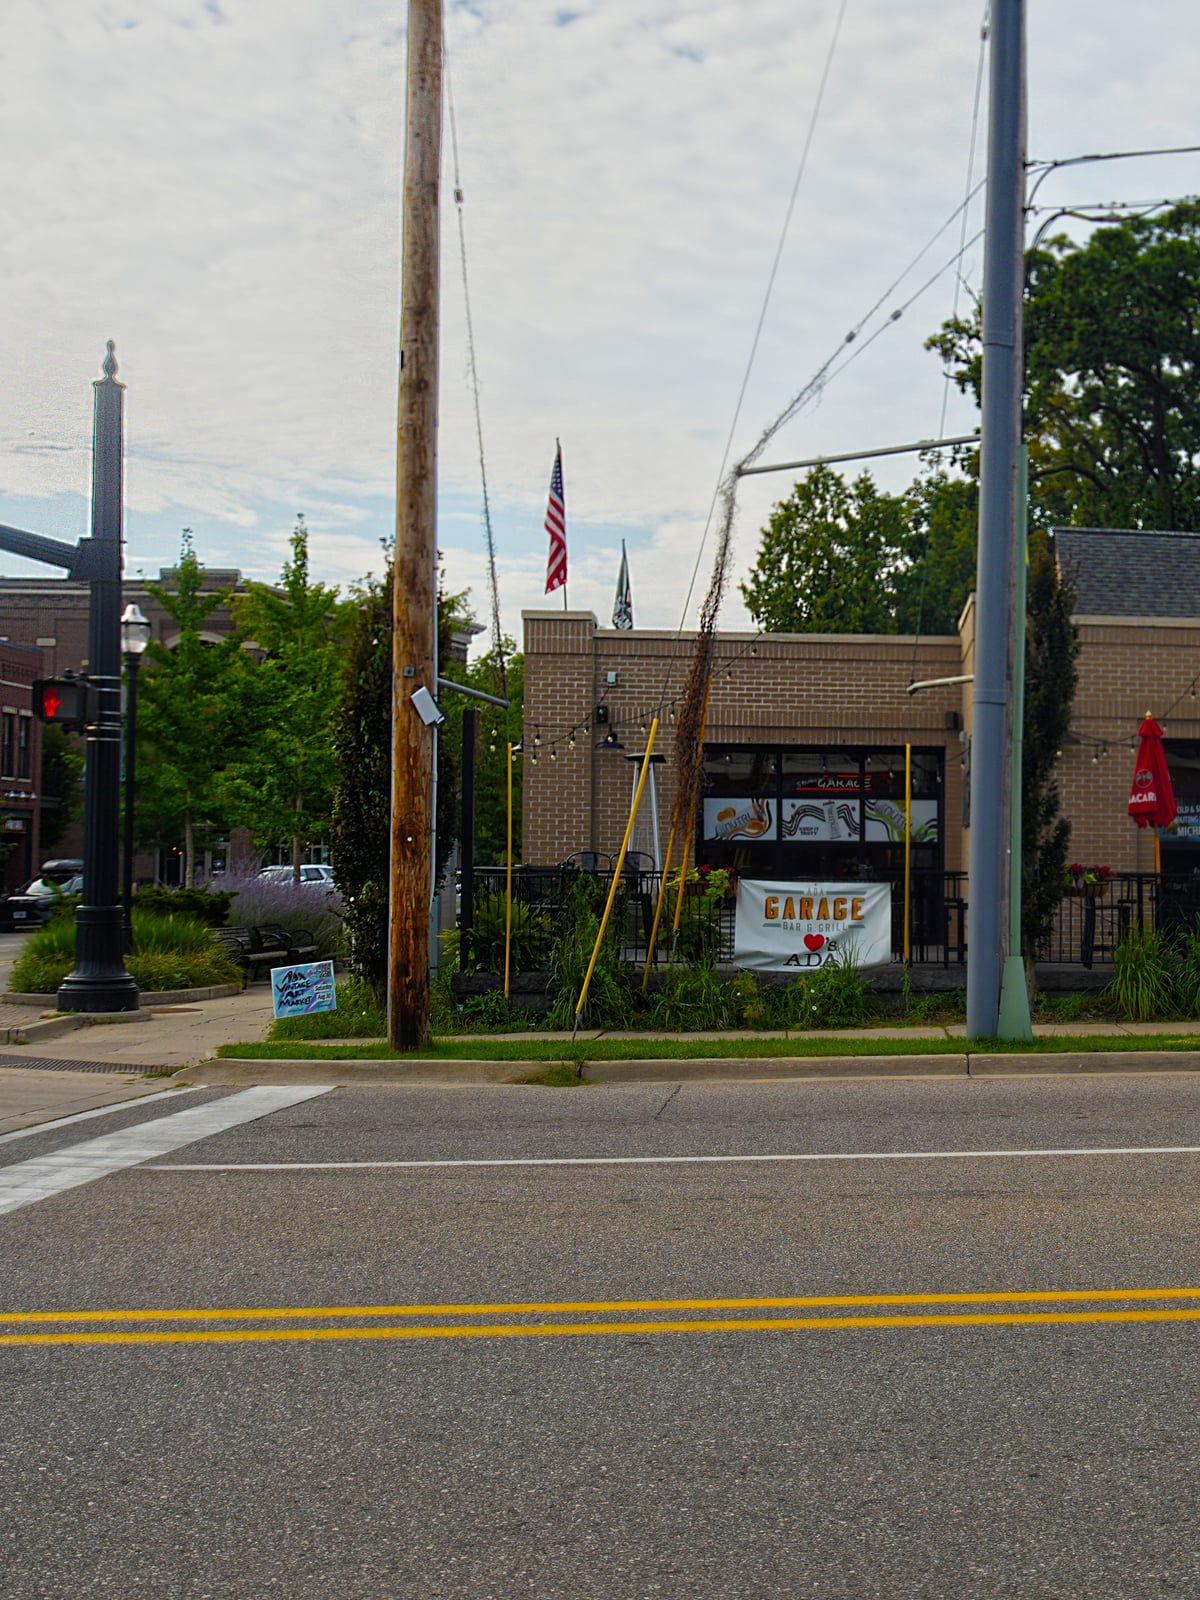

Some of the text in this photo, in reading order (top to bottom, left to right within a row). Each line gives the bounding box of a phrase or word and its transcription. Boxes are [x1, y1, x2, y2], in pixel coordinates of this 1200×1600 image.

[1128, 792, 1157, 804] ACAR
[1176, 805, 1189, 814] OLD
[807, 888, 824, 897] ADA
[765, 896, 865, 921] GARAGE
[783, 922, 848, 933] BAR & GRILL
[783, 952, 840, 967] ADA
[275, 980, 311, 993] VINTAGE
[278, 995, 312, 1010] MARKET
